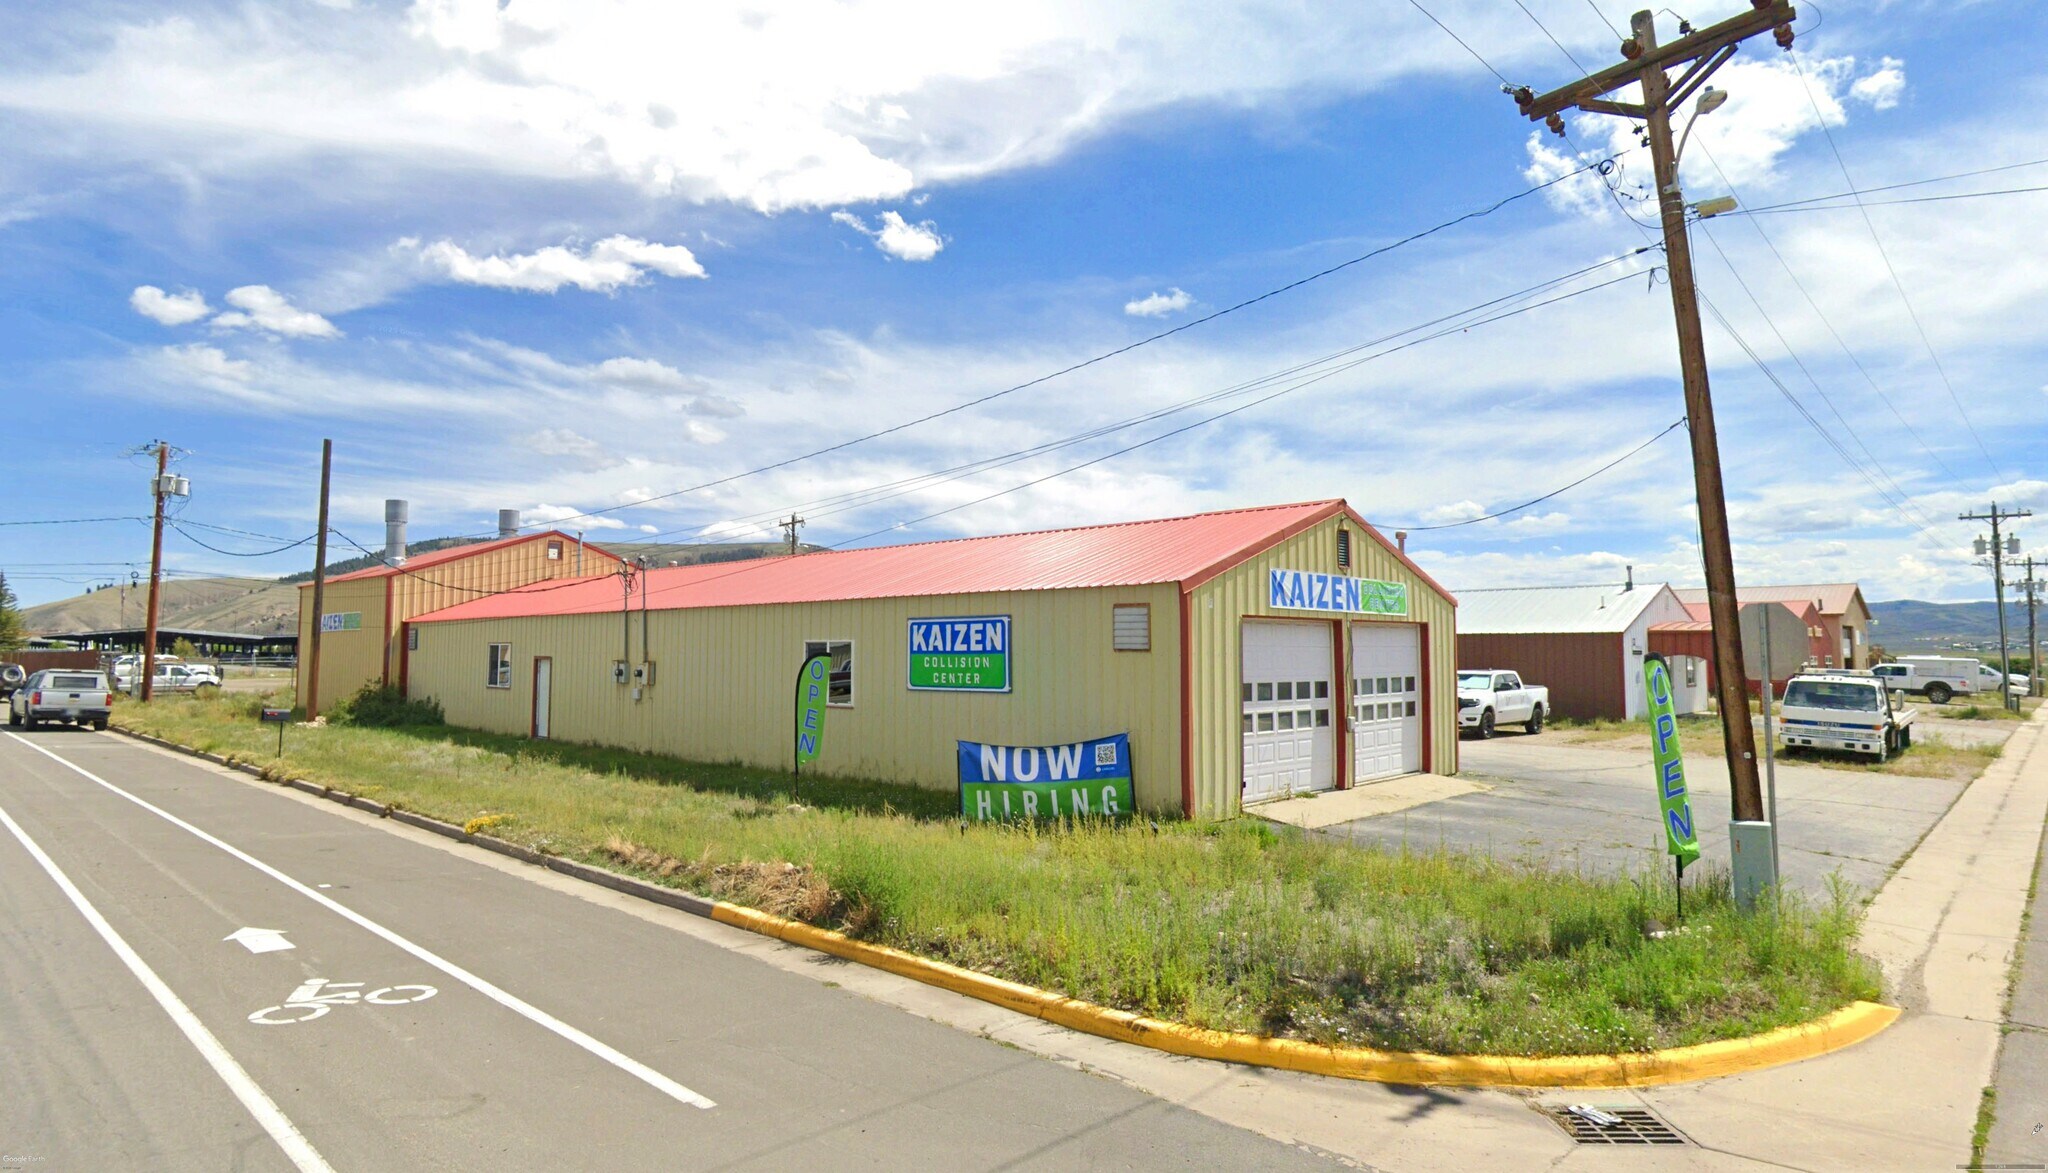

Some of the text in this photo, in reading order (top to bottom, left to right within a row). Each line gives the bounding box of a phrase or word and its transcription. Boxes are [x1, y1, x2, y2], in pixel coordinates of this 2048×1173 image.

[1271, 570, 1360, 611] KAIZEN
[912, 622, 1002, 651] KAIZEN
[924, 656, 990, 668] COLLISION
[933, 672, 981, 684] CENTER
[799, 660, 824, 754] OPEN
[980, 743, 1083, 782] NOW
[1652, 665, 1692, 845] OPEN
[976, 785, 1119, 819] HIRING
